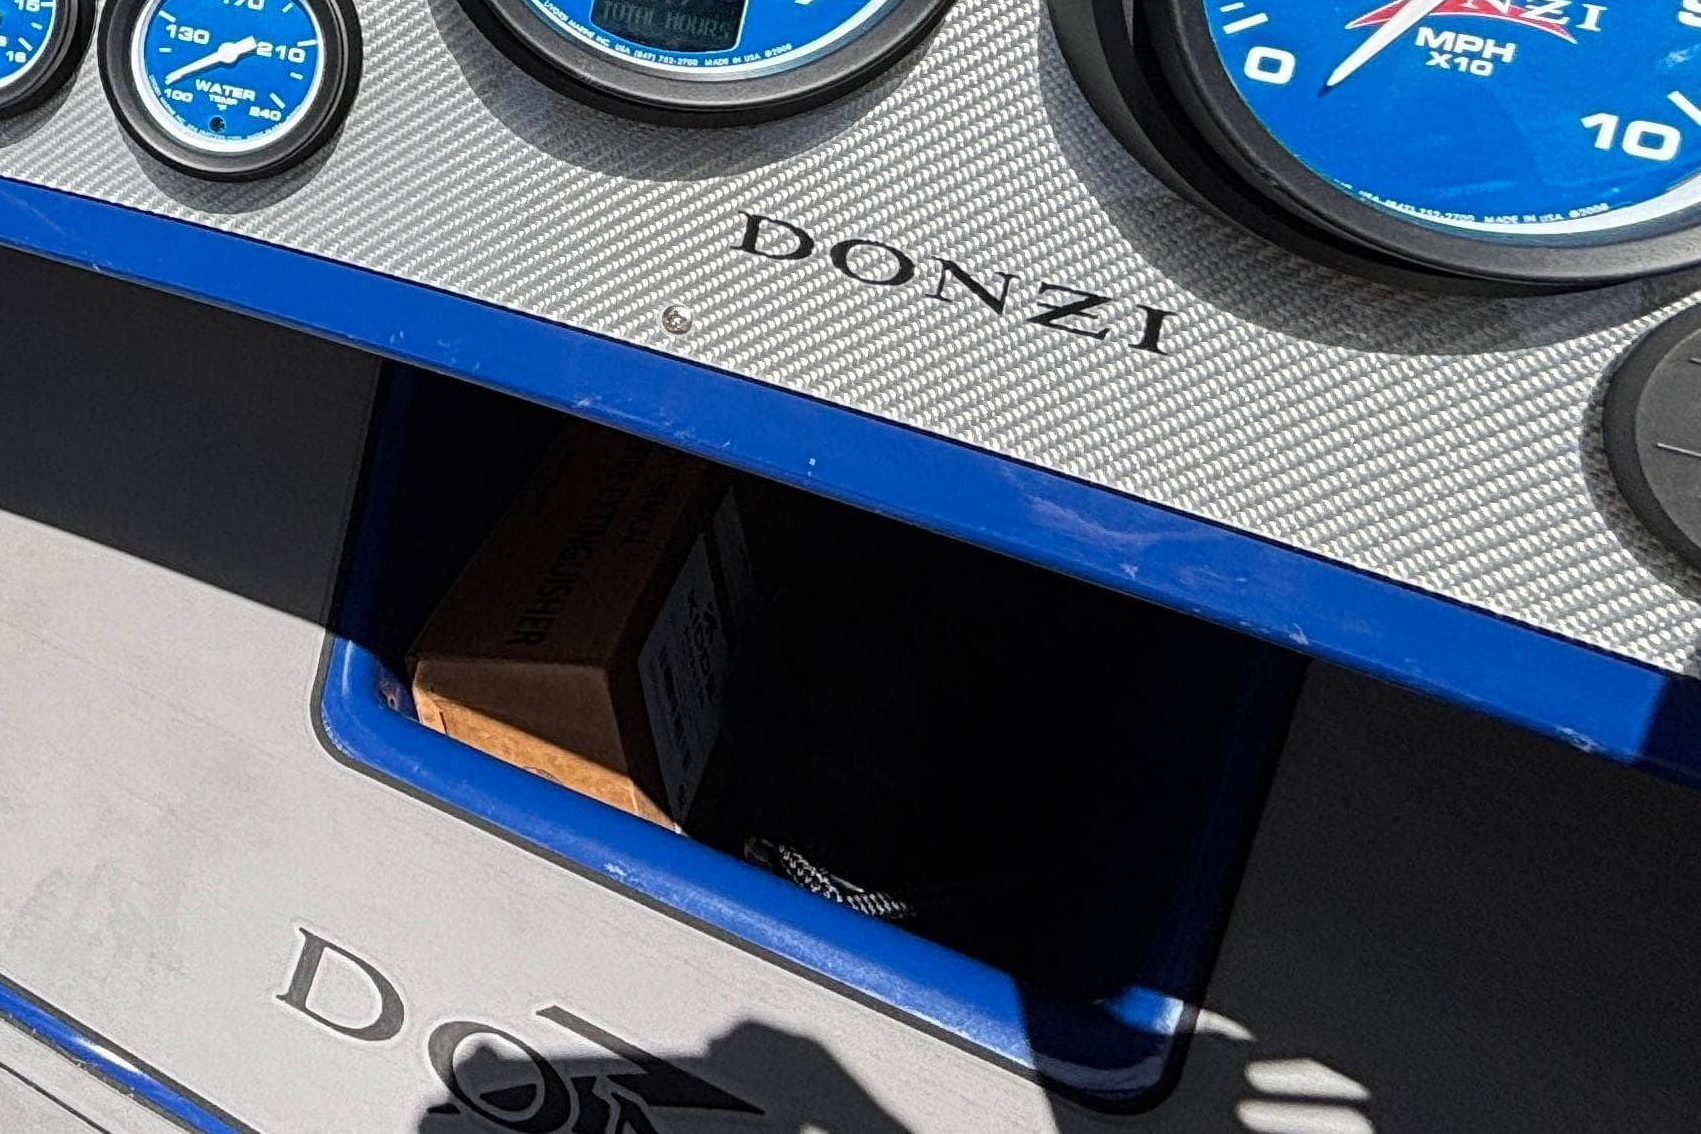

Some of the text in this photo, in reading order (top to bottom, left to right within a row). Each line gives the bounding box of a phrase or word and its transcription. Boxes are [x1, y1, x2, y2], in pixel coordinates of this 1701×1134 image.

[165, 23, 210, 45] 130
[1415, 26, 1517, 63] MPH
[256, 40, 306, 64] 210
[704, 57, 729, 66] MADE
[732, 56, 742, 64] IN
[743, 53, 761, 62] USA
[1425, 51, 1494, 77] X10
[1242, 44, 1296, 85] 0
[164, 88, 194, 104] 100
[195, 78, 256, 102] WATER
[248, 105, 282, 122] 240
[1580, 112, 1682, 162] 10
[729, 210, 1177, 355] DONZI
